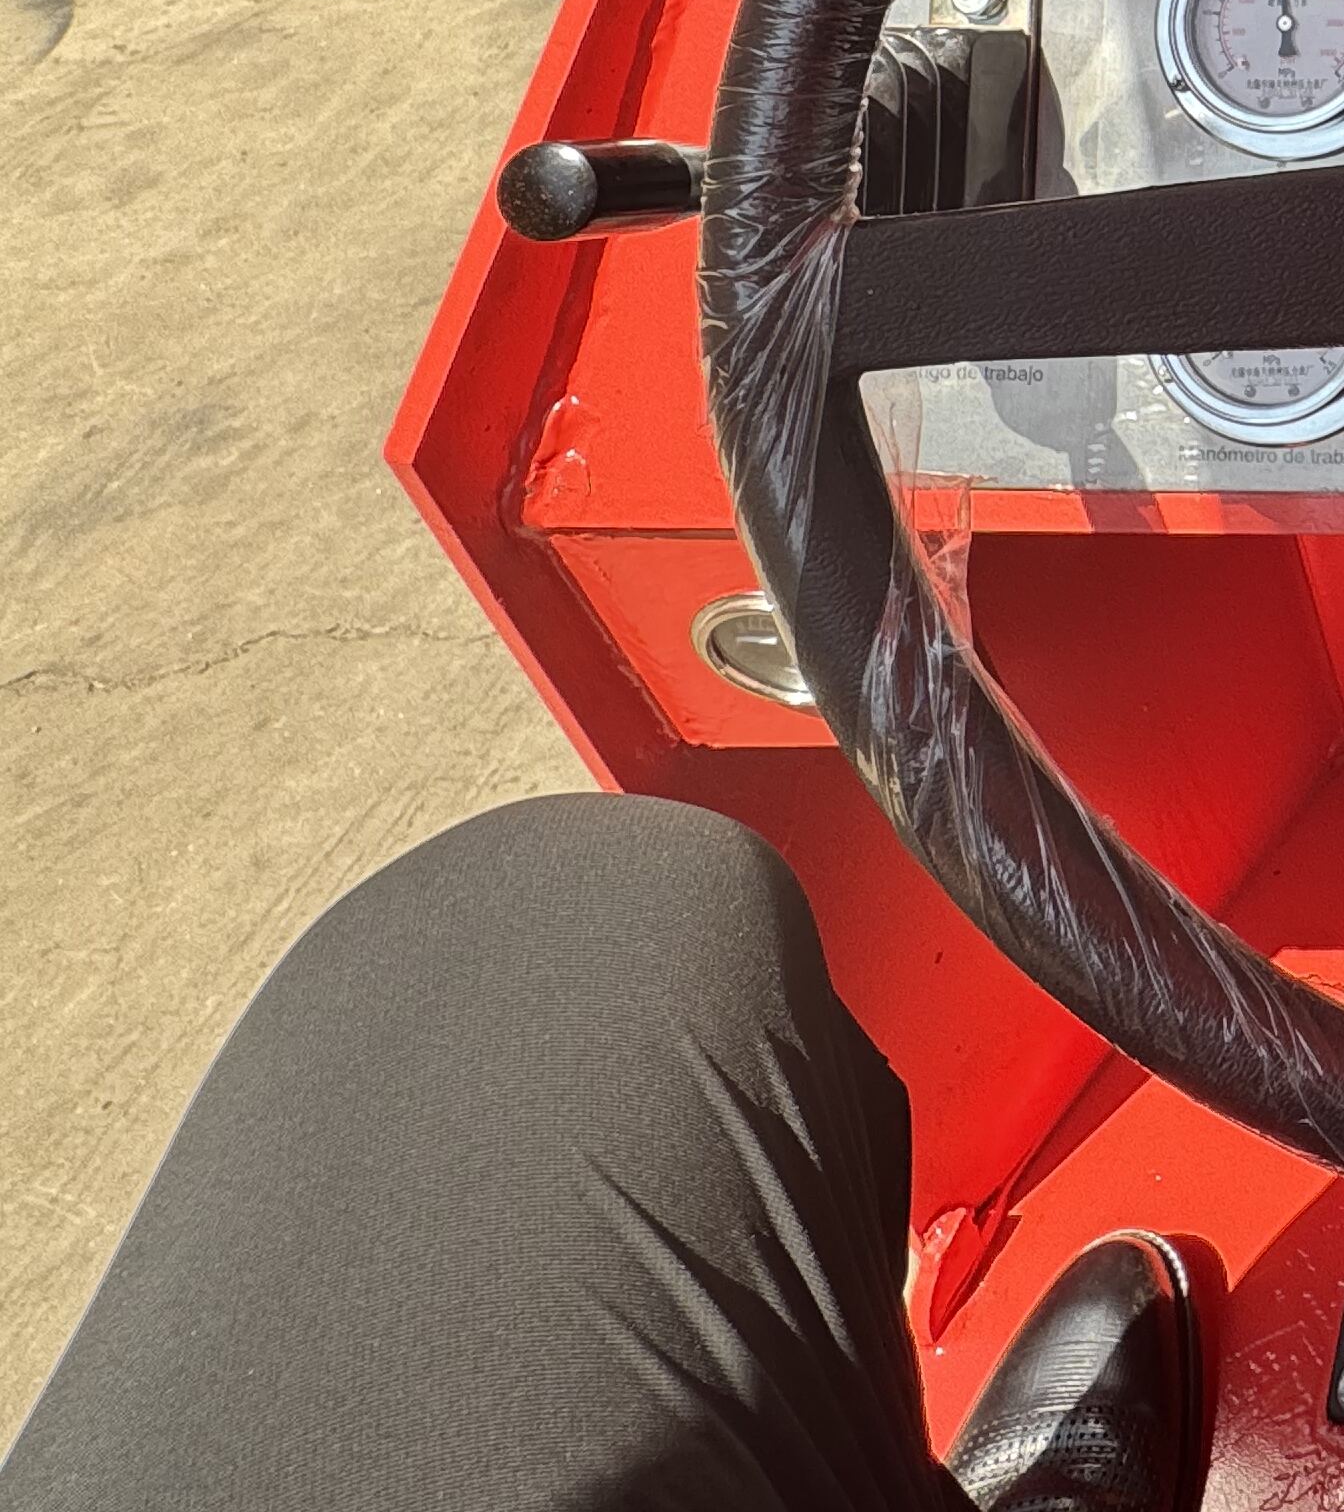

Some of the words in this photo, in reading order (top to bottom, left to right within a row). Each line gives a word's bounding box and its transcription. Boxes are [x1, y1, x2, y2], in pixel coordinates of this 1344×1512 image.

[956, 366, 977, 380] de
[984, 365, 1043, 386] trabajo
[1283, 447, 1305, 464] de
